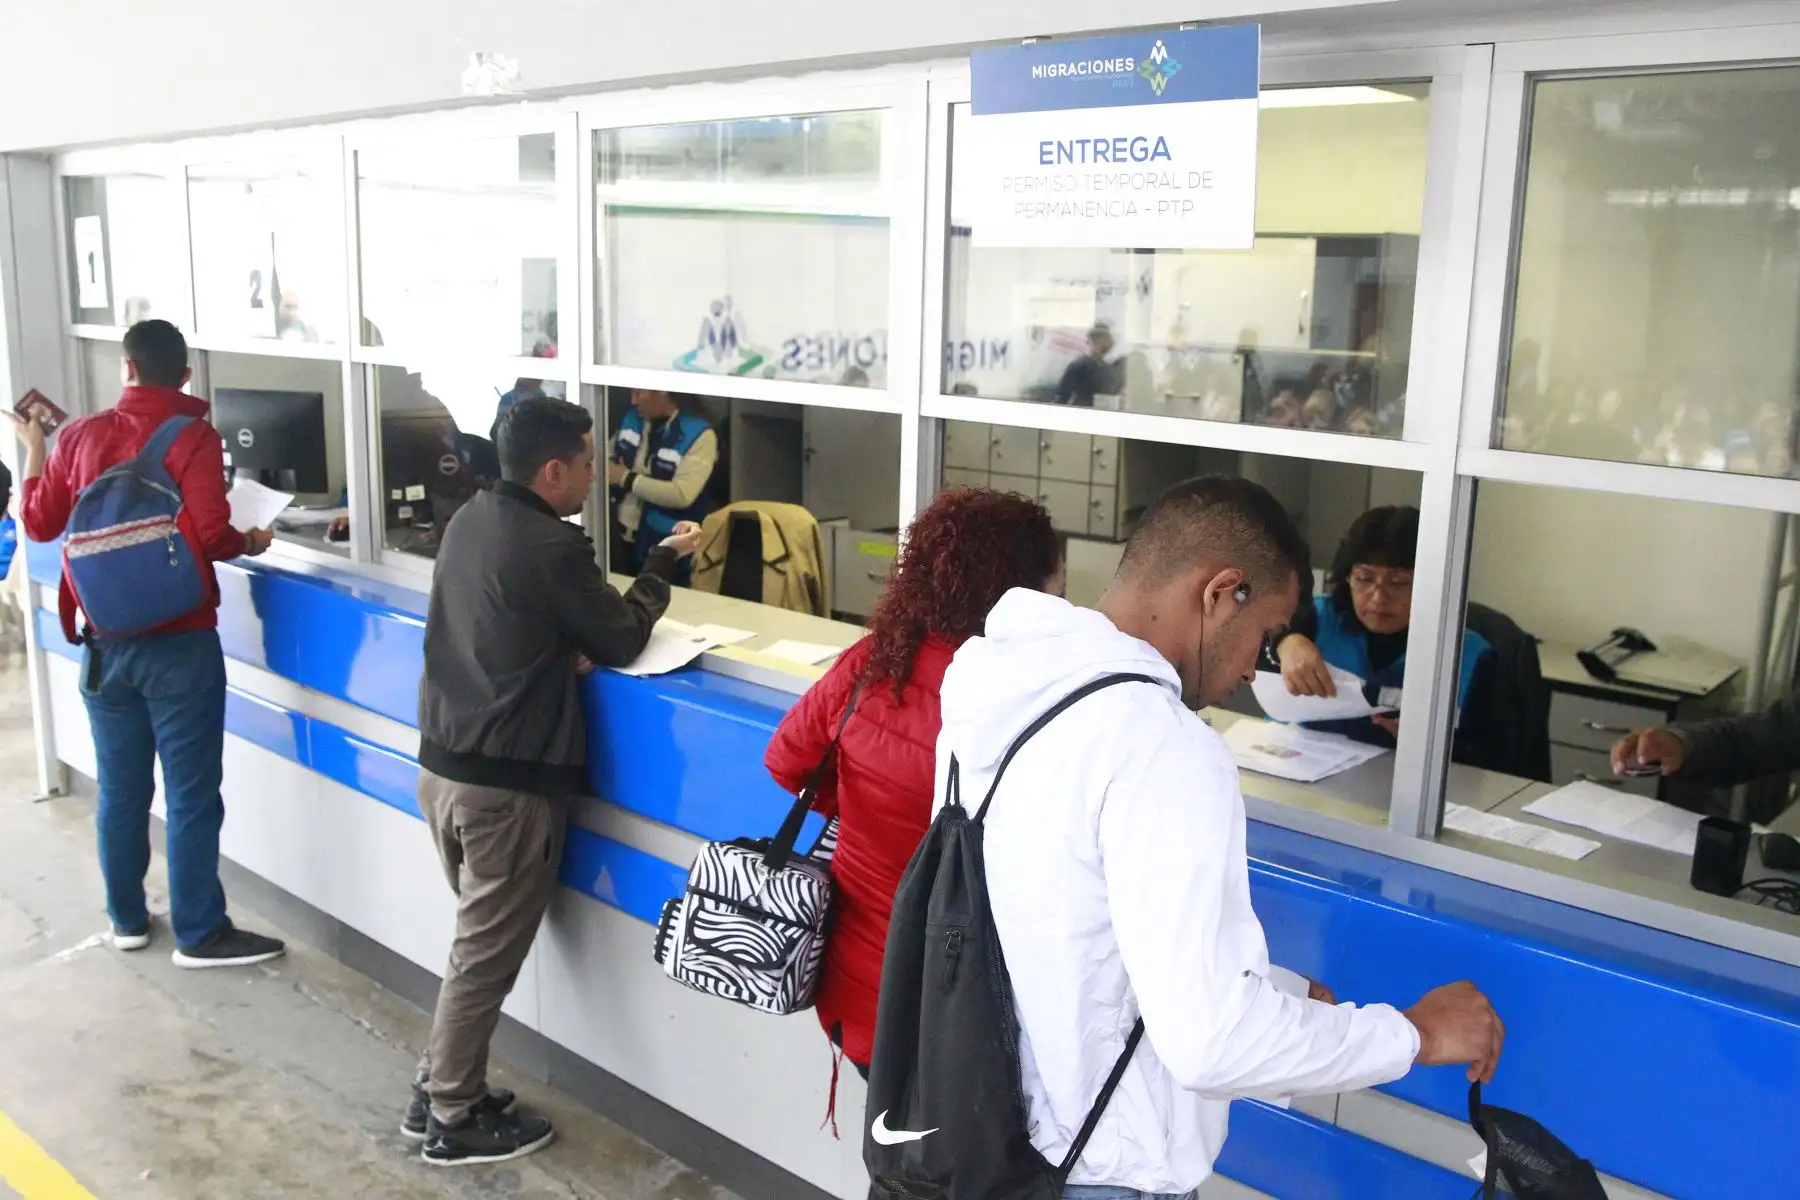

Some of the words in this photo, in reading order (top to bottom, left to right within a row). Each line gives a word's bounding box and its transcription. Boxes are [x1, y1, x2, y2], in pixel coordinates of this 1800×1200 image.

[1032, 57, 1134, 78] MIGRACIONES
[1040, 136, 1172, 165] ENTREGA
[1003, 175, 1078, 194] PERMISO
[1084, 172, 1182, 191] TEMPORAL
[1188, 171, 1214, 189] DE
[1014, 200, 1138, 218] PERMANENCIA
[1158, 199, 1194, 217] PTP
[88, 251, 96, 284] 1
[249, 269, 264, 308] 2
